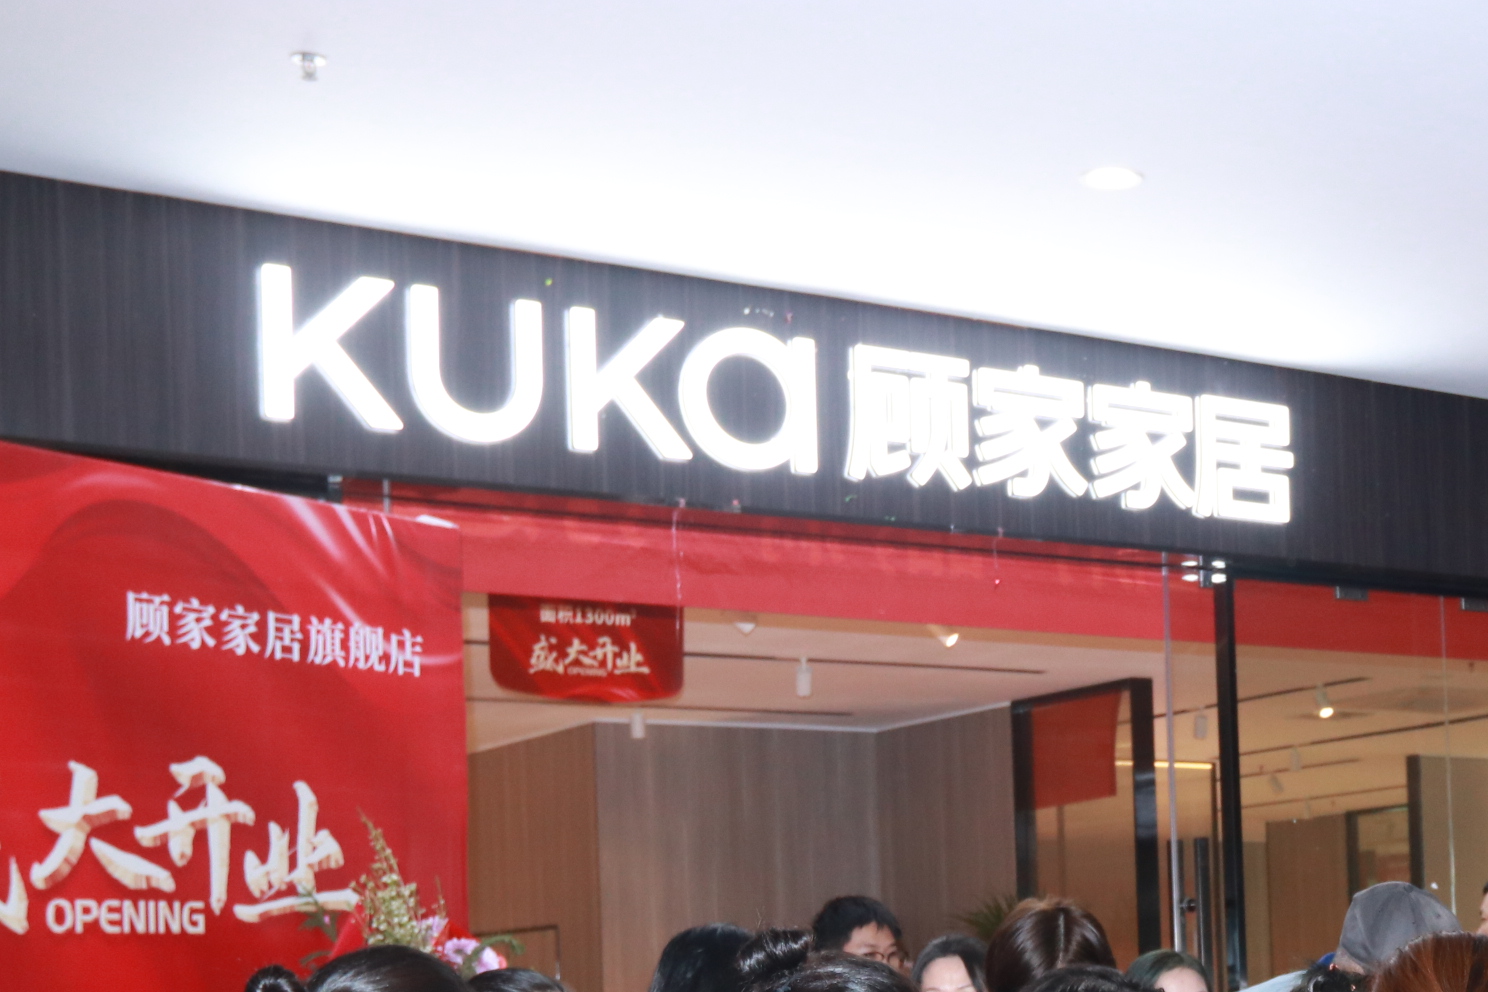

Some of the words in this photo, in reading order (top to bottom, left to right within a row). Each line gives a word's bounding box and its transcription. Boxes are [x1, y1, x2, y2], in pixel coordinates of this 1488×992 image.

[844, 342, 1295, 525] 顾家家居
[125, 590, 424, 678] 顾家家居旗舰店
[529, 634, 651, 674] 盛大开业
[0, 755, 361, 935] 大开业
[45, 898, 207, 935] OPENING
